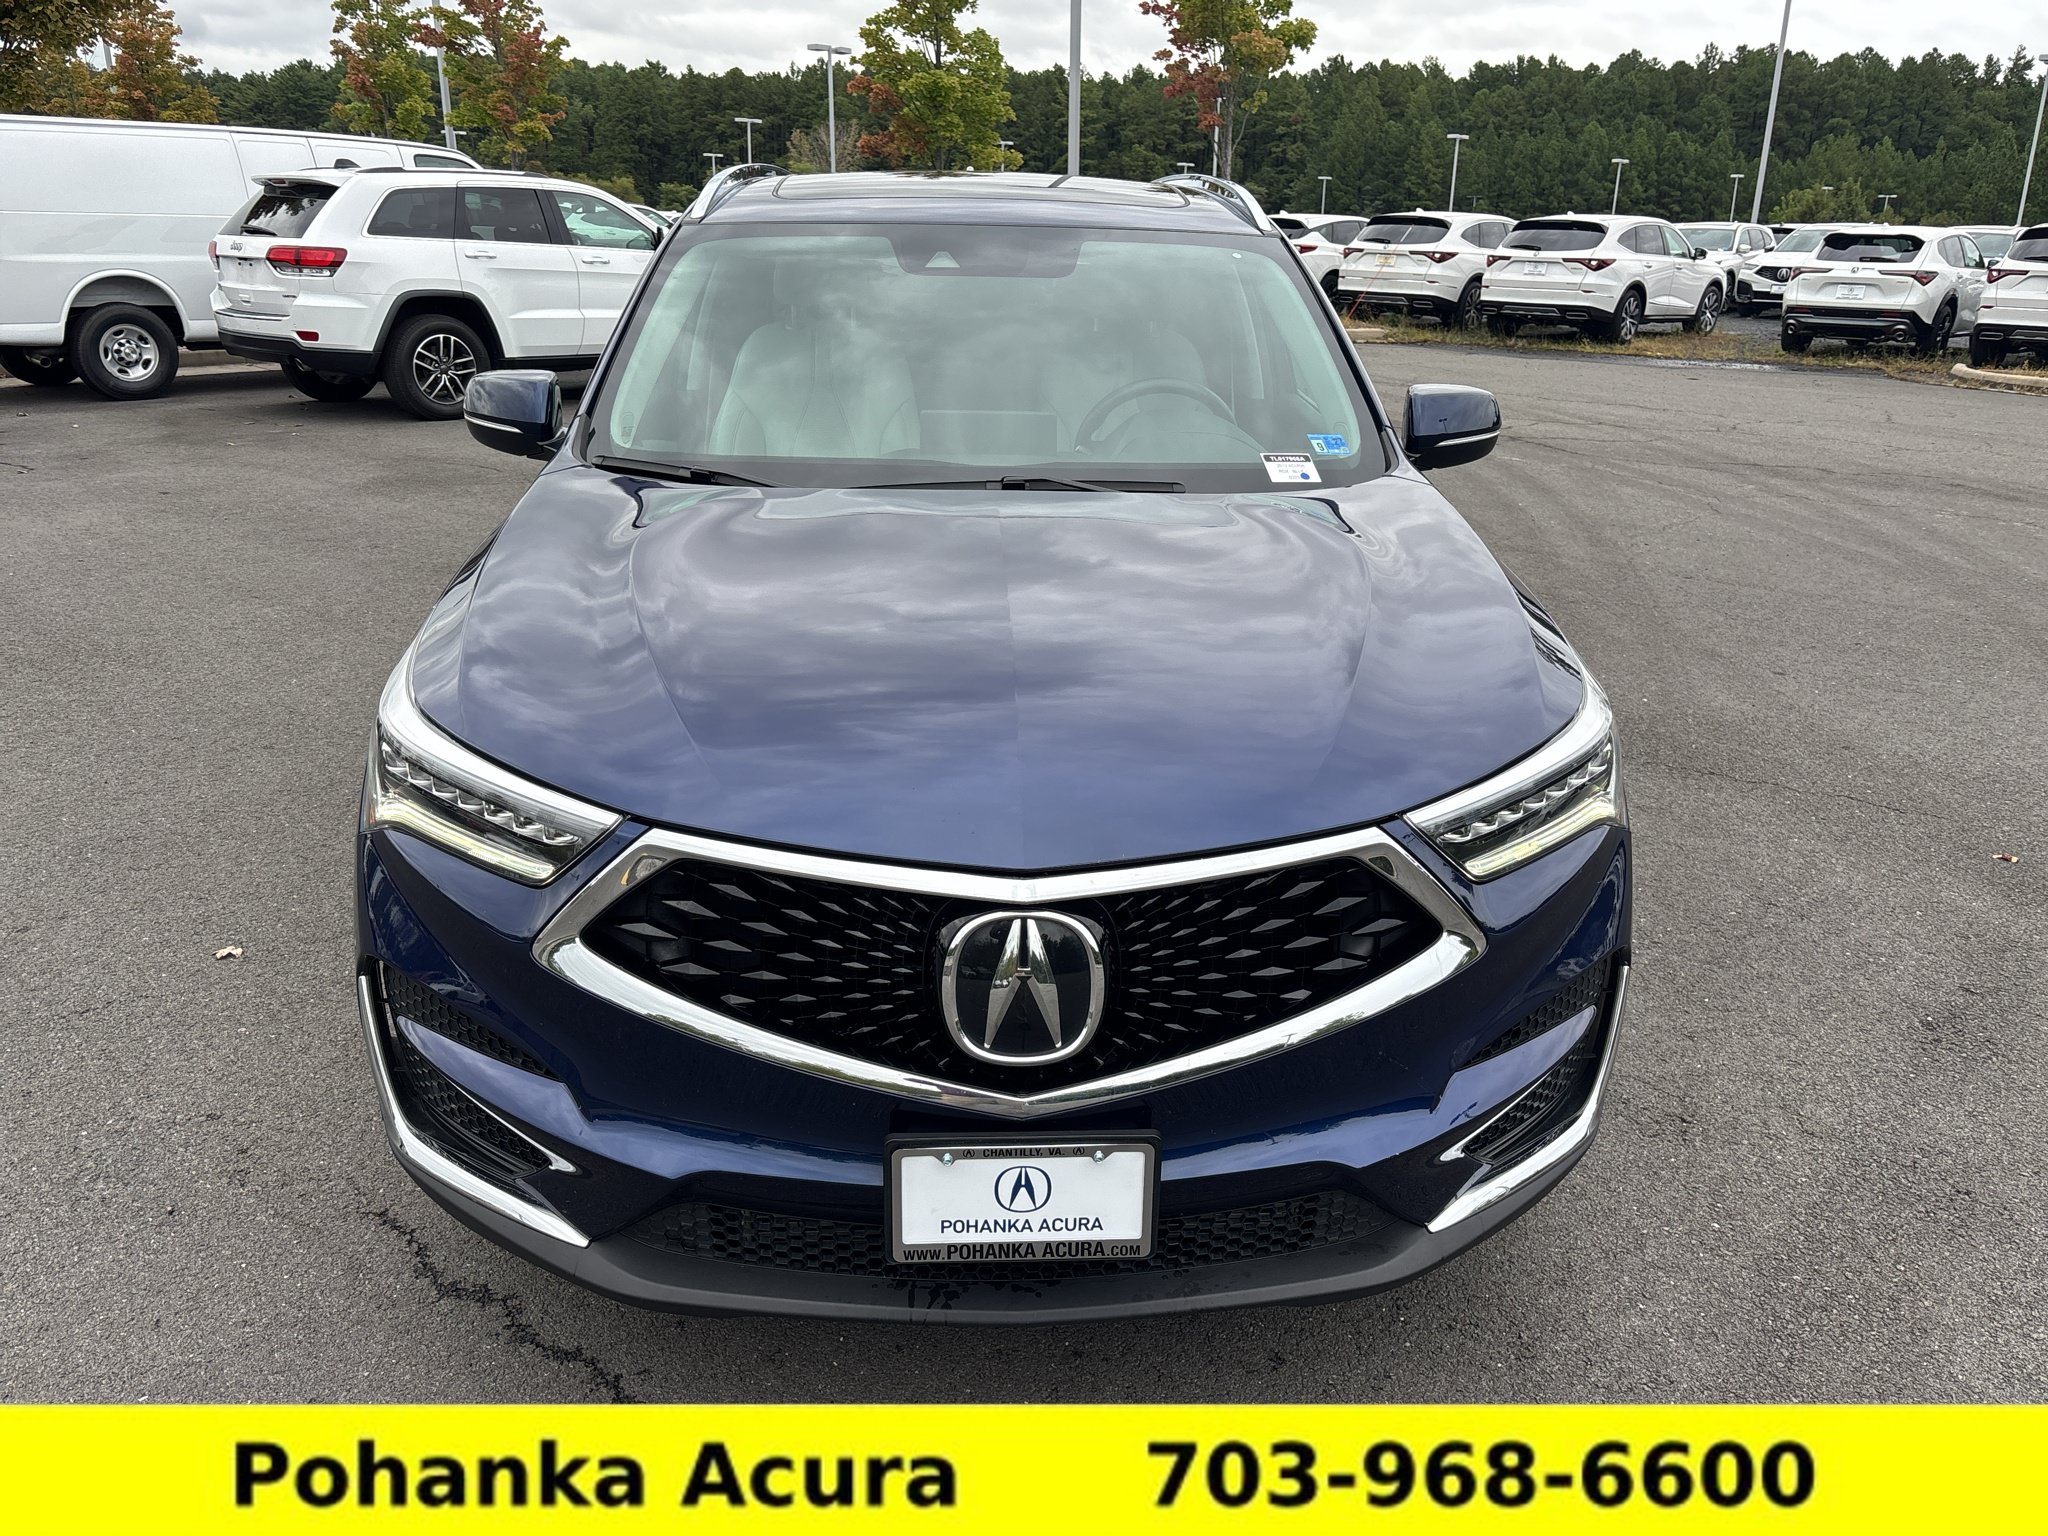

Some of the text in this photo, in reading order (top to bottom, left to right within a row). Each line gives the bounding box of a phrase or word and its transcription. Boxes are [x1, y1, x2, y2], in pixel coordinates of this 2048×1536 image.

[1316, 442, 1325, 451] 9
[983, 1147, 1066, 1157] CHANTILLY, VA.
[940, 1217, 1104, 1234] POHANKA ACURA
[1042, 1240, 1141, 1259] ACURA.COM
